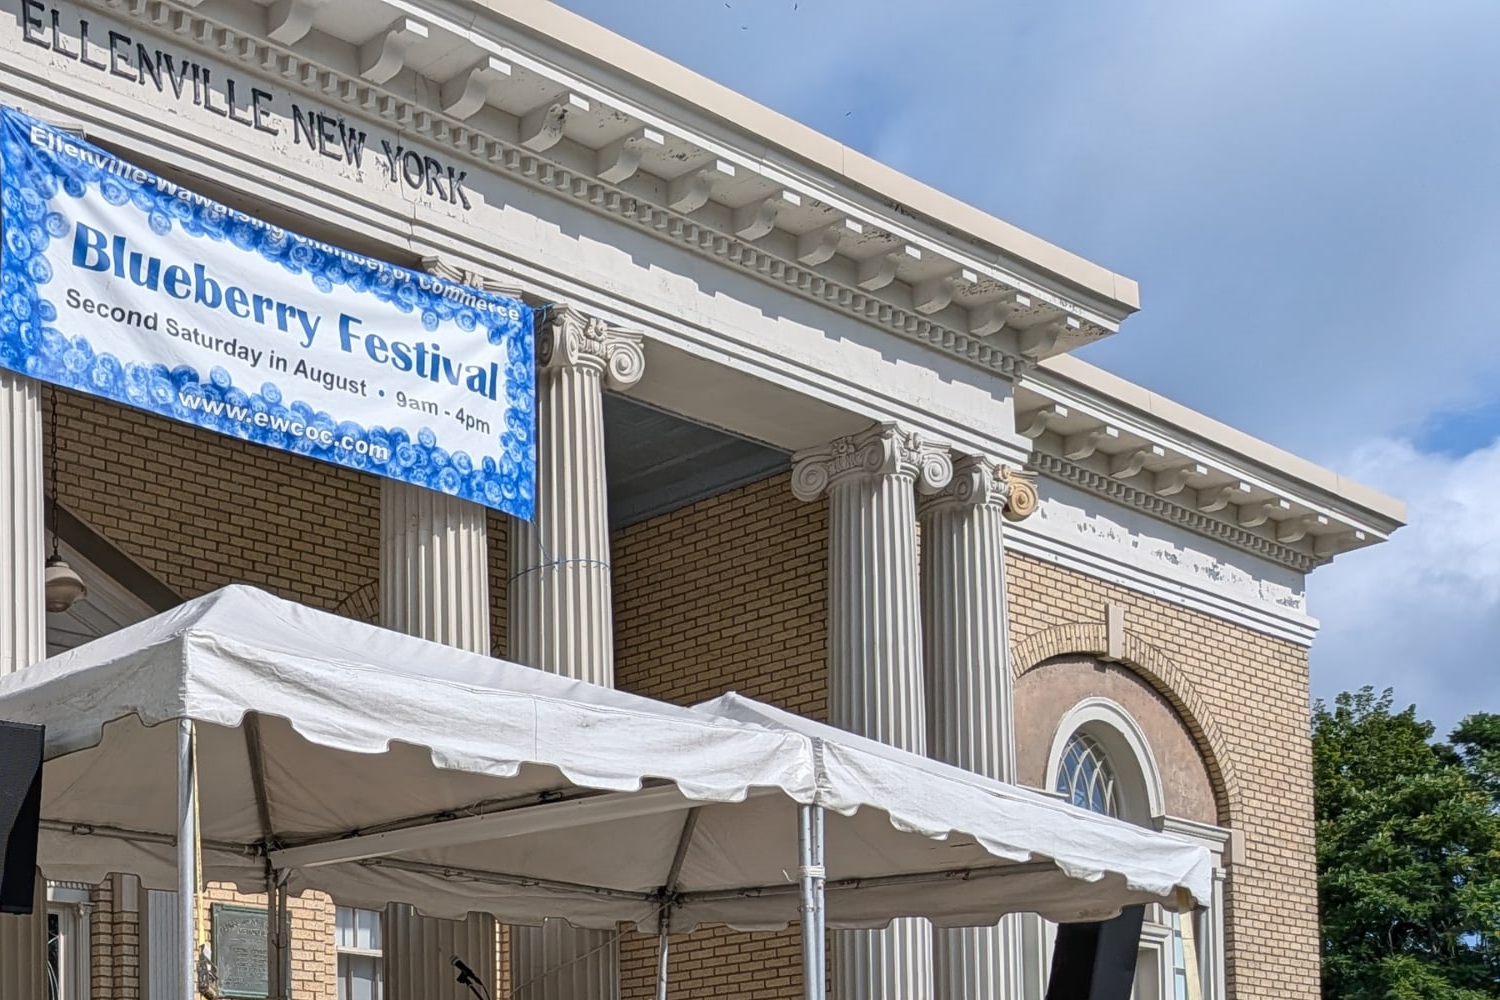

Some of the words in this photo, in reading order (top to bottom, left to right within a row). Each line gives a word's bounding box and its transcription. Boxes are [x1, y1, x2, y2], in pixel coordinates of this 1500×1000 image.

[22, 0, 279, 136] ELLENVILLE
[291, 104, 367, 169] NEW
[381, 139, 472, 210] YORK
[66, 288, 158, 331] Second
[166, 318, 263, 368] Saturday
[269, 350, 288, 372] in
[293, 359, 368, 397] August
[396, 390, 439, 416] 9am
[455, 408, 491, 435] 4pm
[71, 221, 322, 349] Blueberry
[339, 312, 499, 401] Festival
[419, 276, 521, 321] Commerce
[178, 391, 389, 461] www.ewcoc.com
